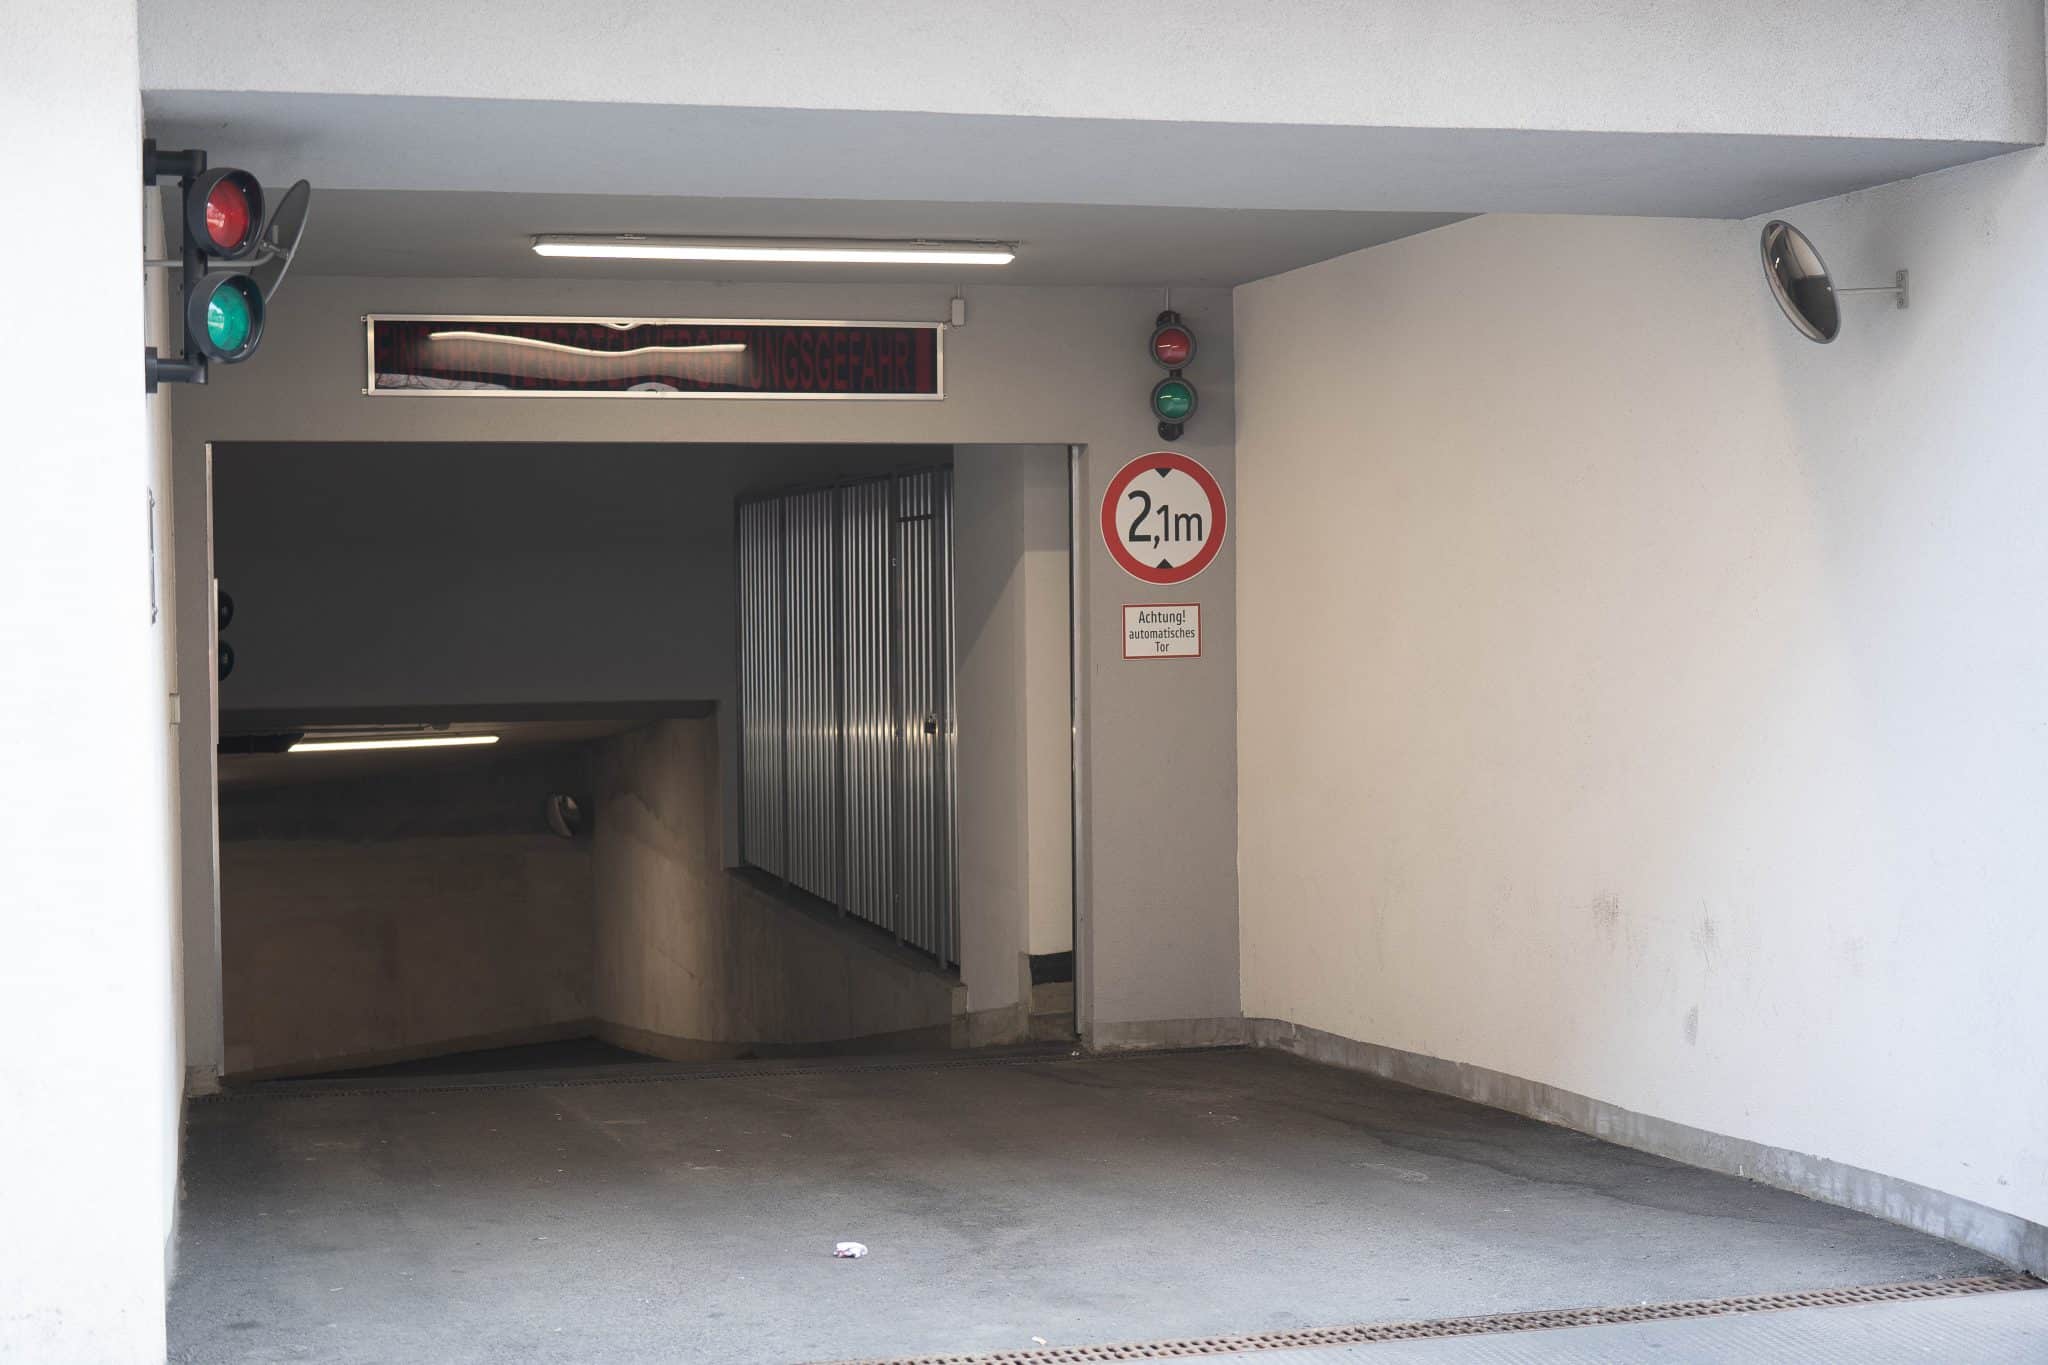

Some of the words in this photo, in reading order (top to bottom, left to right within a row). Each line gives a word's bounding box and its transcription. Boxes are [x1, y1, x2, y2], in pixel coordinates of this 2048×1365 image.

[1127, 490, 1203, 550] 2,1m
[1138, 609, 1186, 626] Achtung!
[1129, 627, 1196, 640] automatisches
[1155, 641, 1170, 653] Tor
